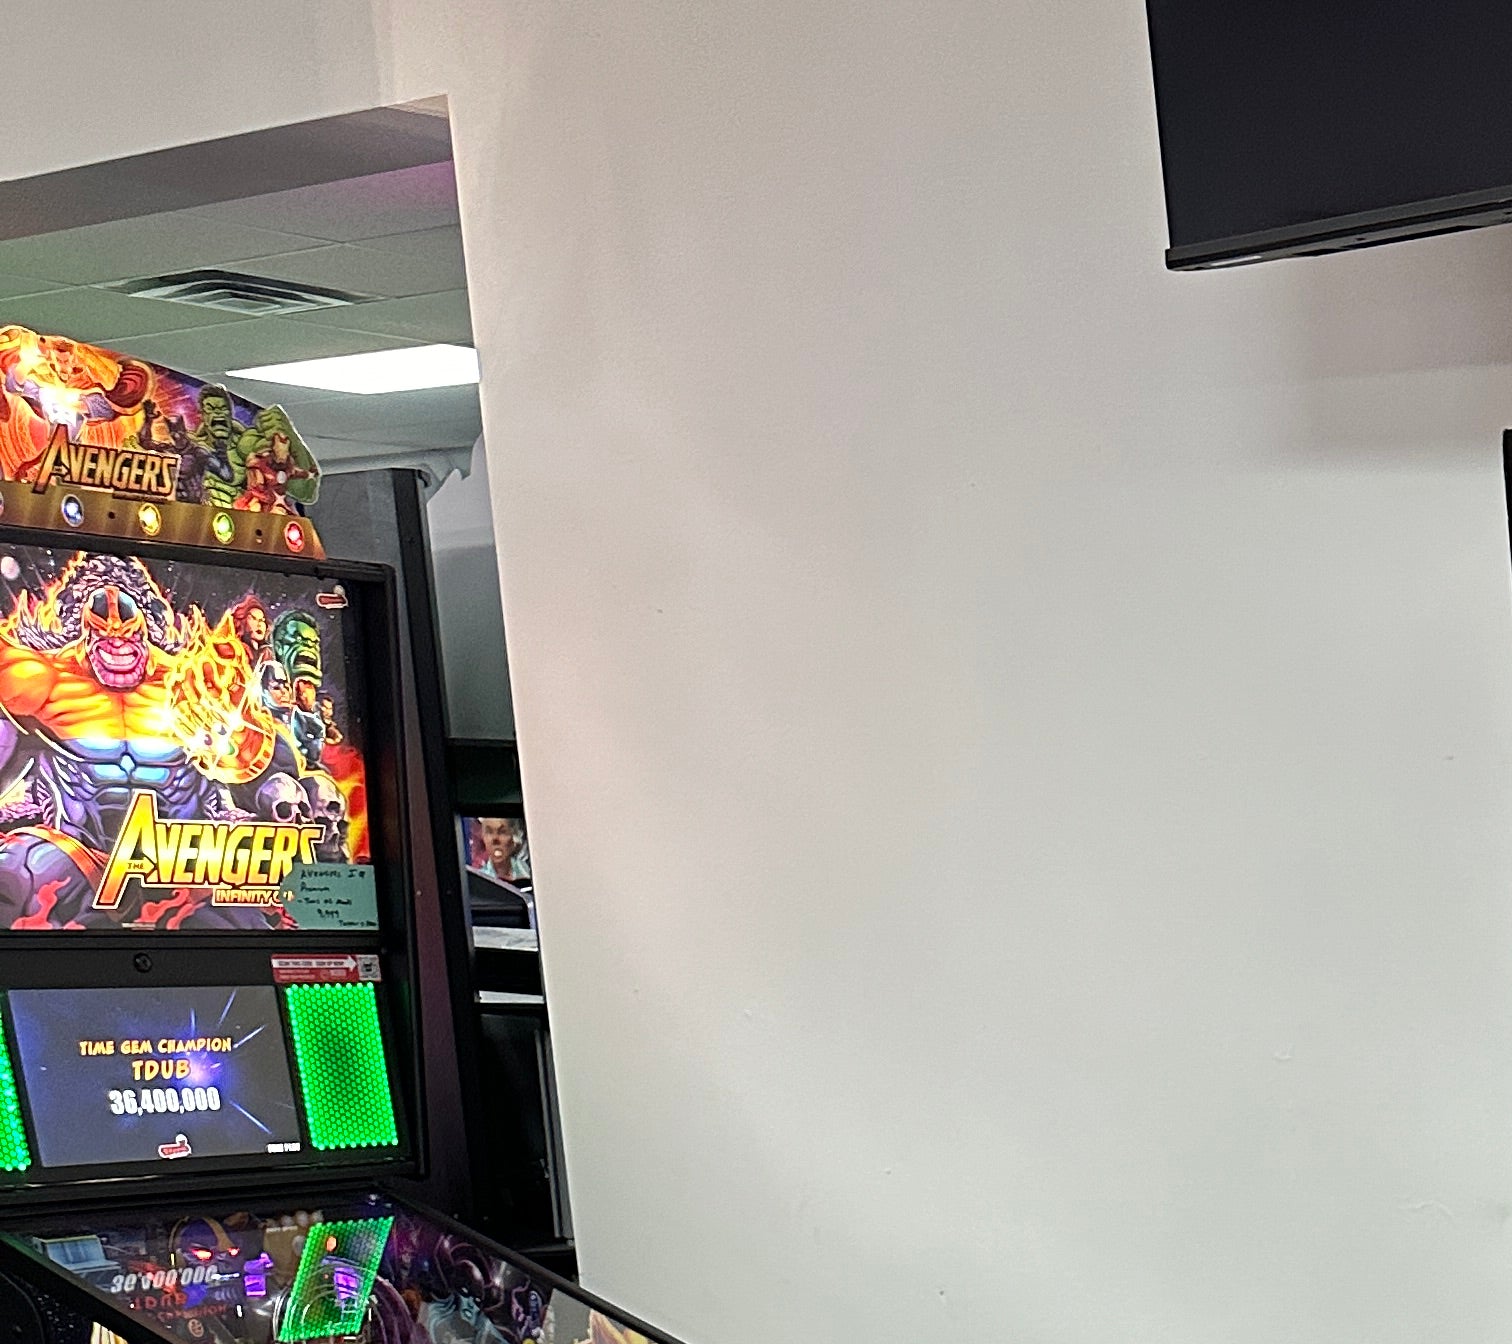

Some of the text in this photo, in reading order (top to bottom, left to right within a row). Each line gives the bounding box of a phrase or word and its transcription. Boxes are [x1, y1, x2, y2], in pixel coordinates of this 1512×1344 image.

[32, 424, 179, 494] AVENGERS
[79, 1036, 232, 1056] TIME GEM CHAMPION
[132, 1058, 191, 1081] TDUB
[108, 1086, 221, 1116] 36,400,000
